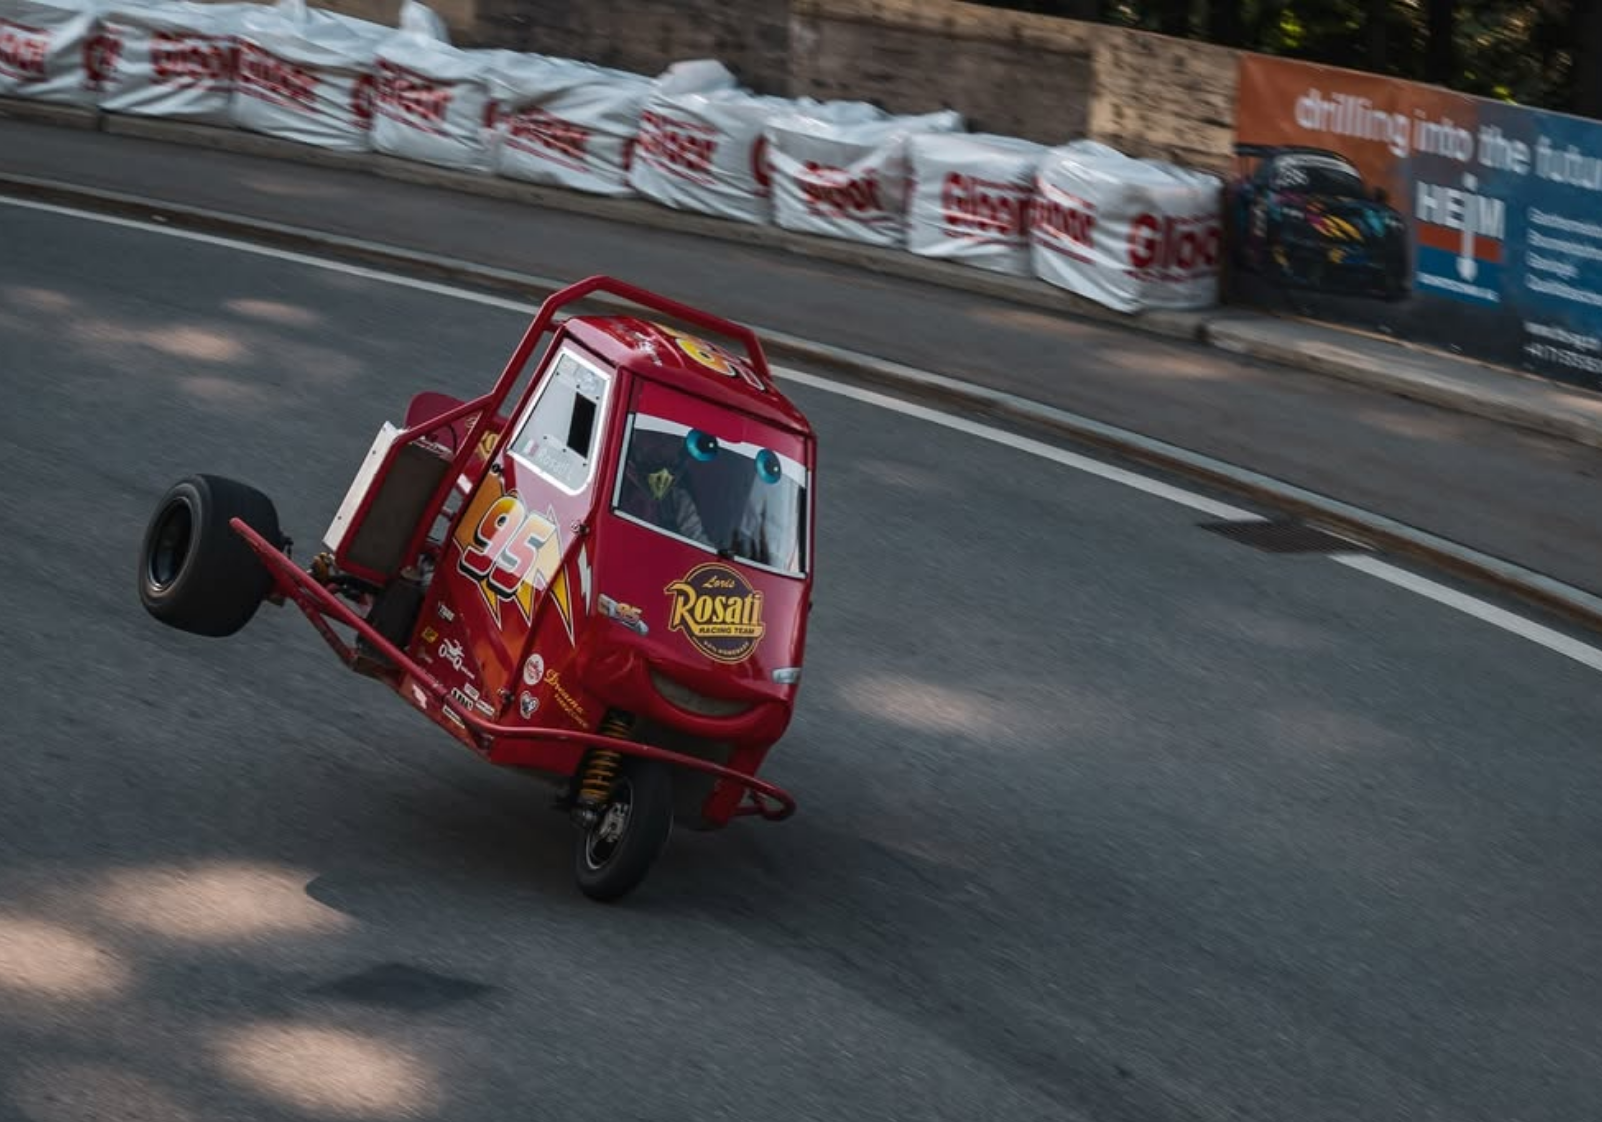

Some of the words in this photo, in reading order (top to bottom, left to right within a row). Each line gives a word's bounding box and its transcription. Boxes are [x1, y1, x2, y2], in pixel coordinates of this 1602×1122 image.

[1294, 88, 1411, 158] drilling
[1413, 109, 1474, 162] into
[1478, 124, 1530, 175] the
[456, 494, 558, 601] 95
[666, 582, 762, 634] Rosati
[699, 626, 732, 634] RACING
[734, 626, 755, 635] TEAM
